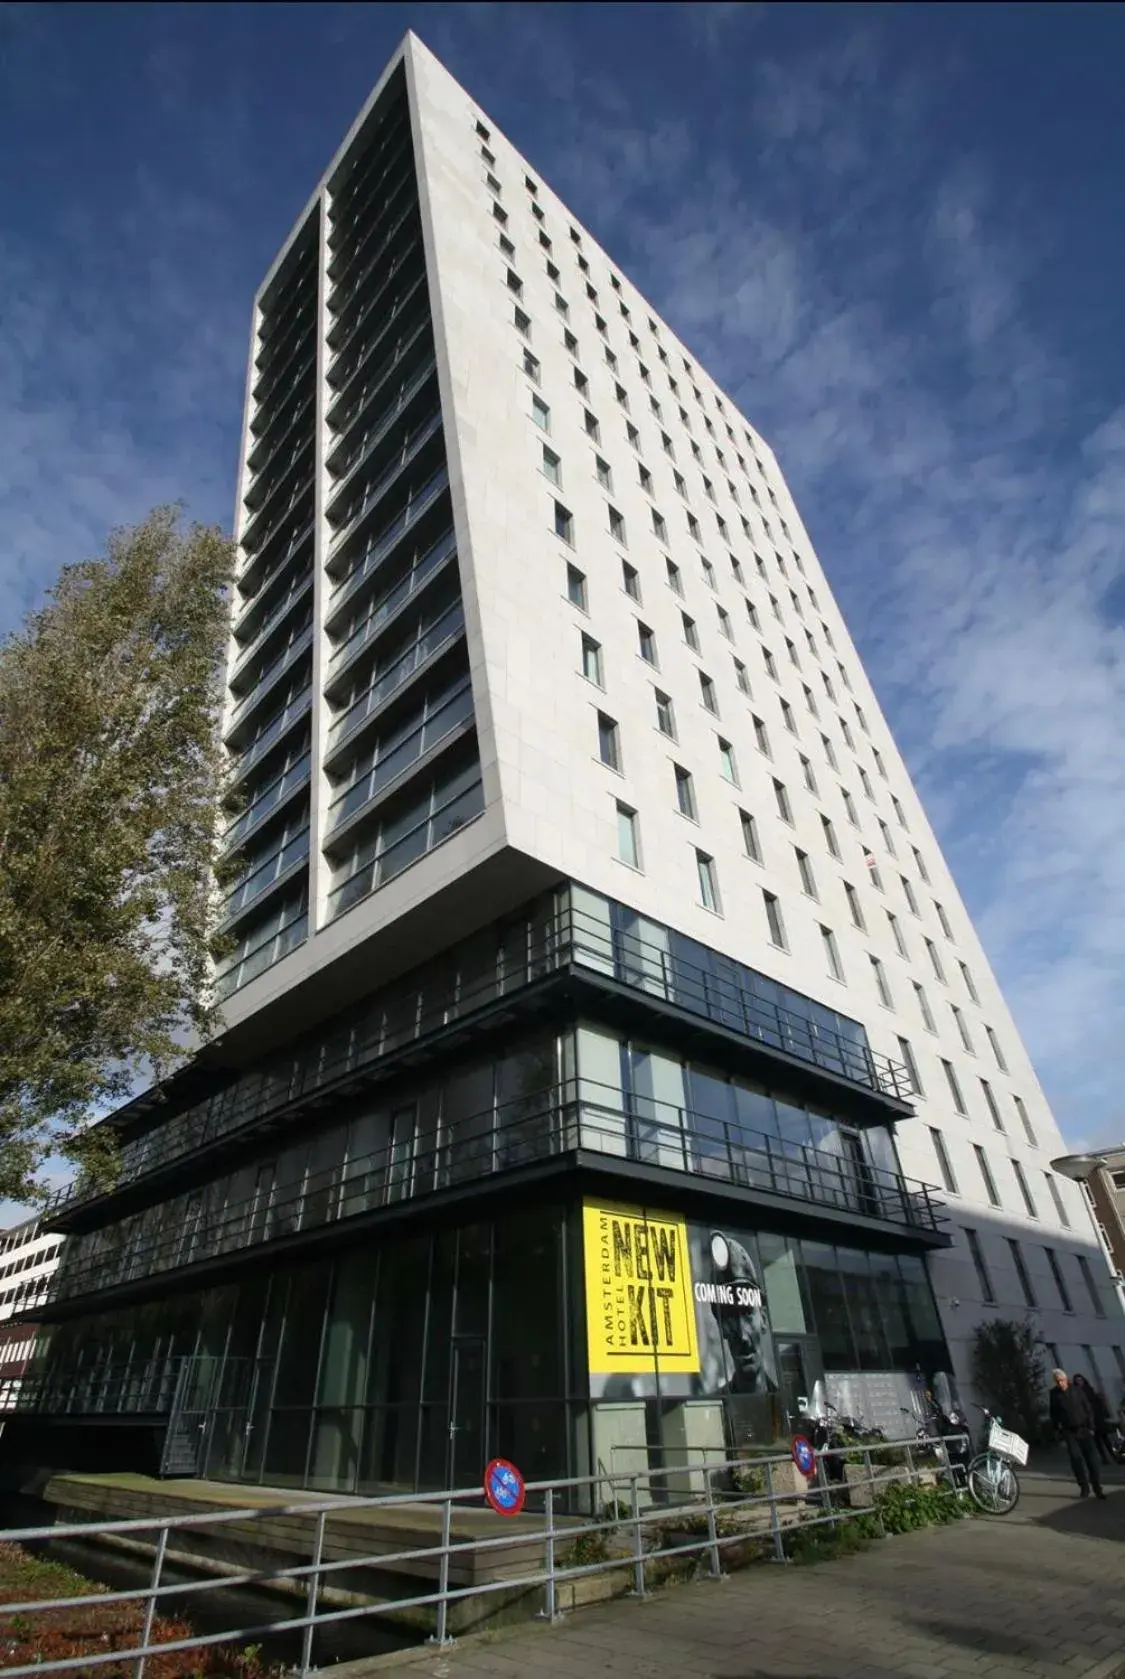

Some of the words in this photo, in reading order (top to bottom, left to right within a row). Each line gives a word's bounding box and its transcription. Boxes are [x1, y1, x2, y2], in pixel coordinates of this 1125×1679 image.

[600, 1217, 614, 1345] AMSTERDAM
[612, 1220, 676, 1283] NEW
[617, 1287, 626, 1347] HOTEL
[627, 1284, 674, 1347] KIT
[694, 1282, 734, 1305] COMING
[736, 1287, 762, 1307] SOON
